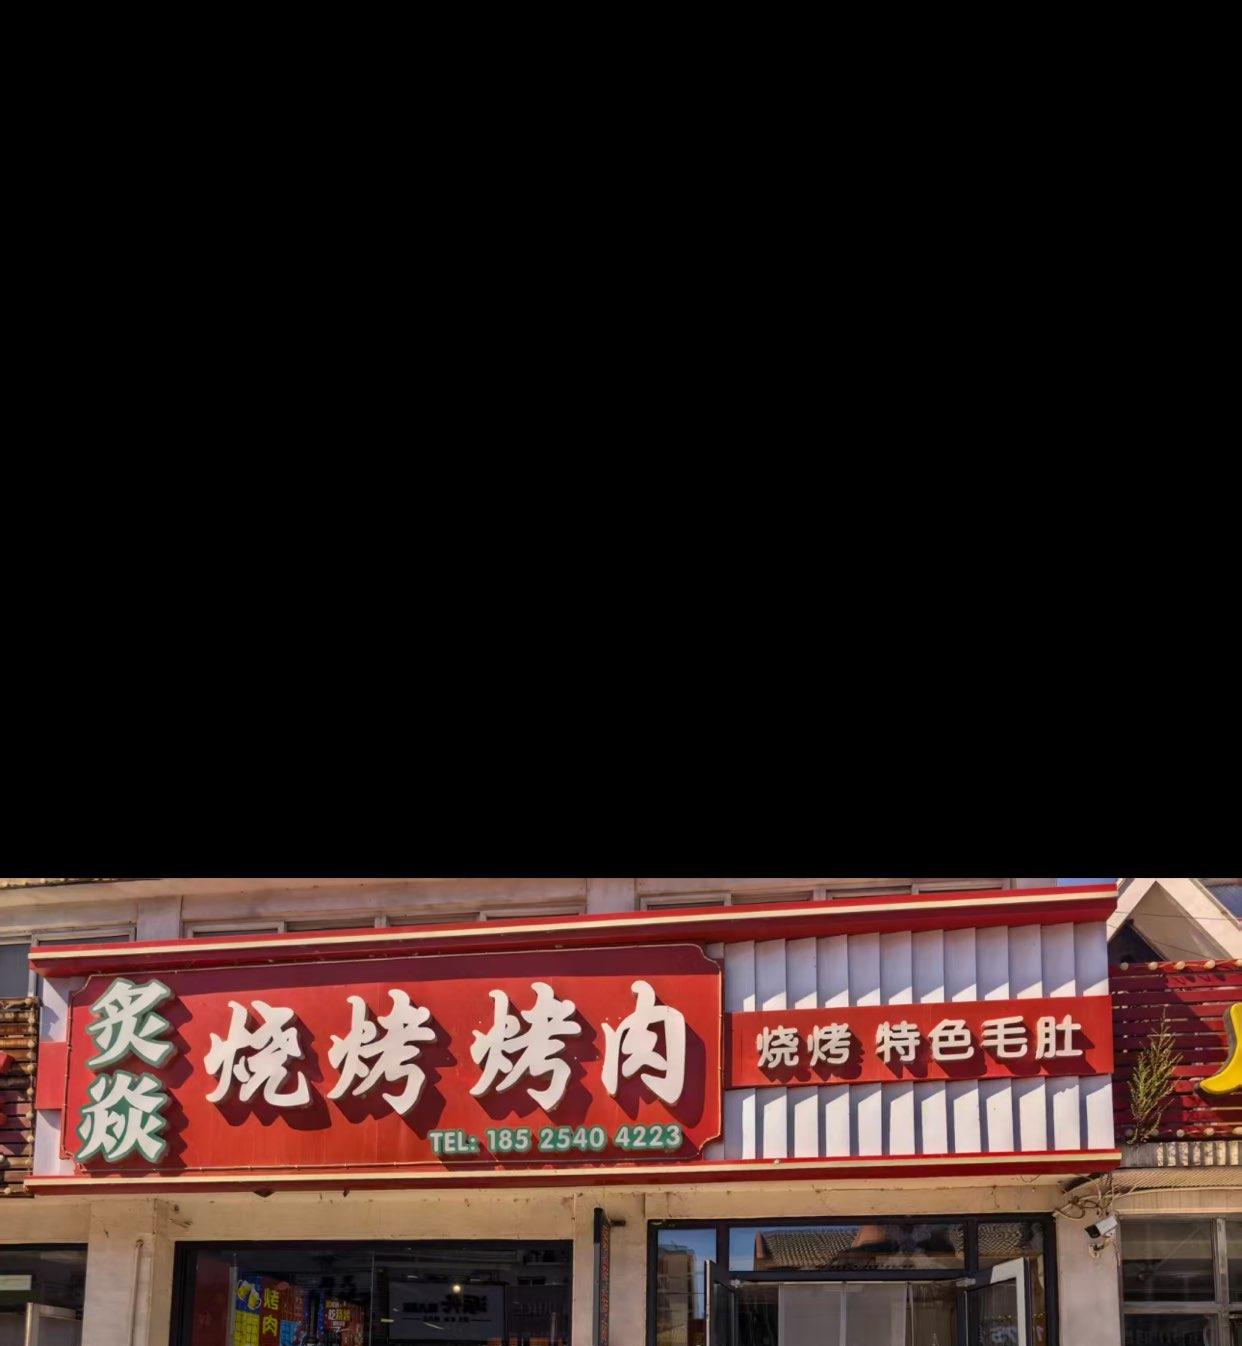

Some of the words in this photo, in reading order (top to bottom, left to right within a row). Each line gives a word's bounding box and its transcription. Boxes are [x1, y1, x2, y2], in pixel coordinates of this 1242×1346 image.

[757, 1023, 851, 1068] 烧烤
[875, 1014, 1083, 1064] 特色毛肚
[75, 977, 175, 1164] 炙焱
[428, 1130, 479, 1154] TEL:
[485, 1128, 529, 1151] 185
[538, 1127, 606, 1152] 2540
[614, 1125, 683, 1149] 4223
[264, 1288, 279, 1336] 烤肉
